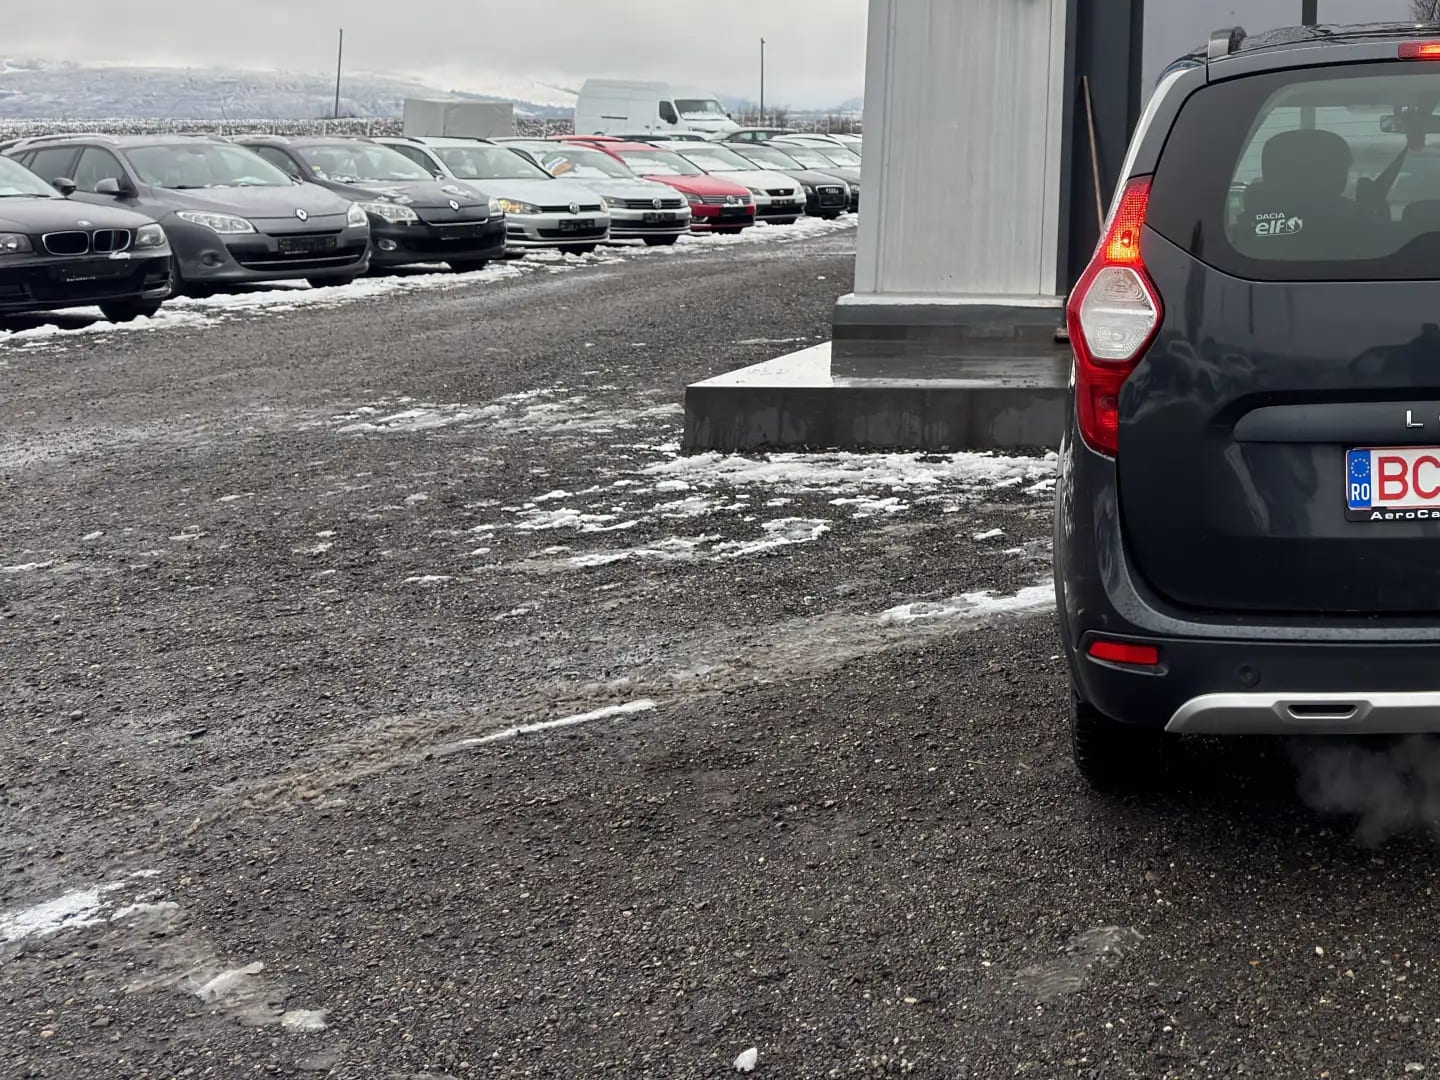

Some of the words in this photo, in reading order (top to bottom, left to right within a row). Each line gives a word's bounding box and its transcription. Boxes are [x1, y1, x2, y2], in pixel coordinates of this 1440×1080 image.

[1256, 212, 1286, 220] DACIA
[1255, 219, 1286, 234] elf
[1351, 483, 1370, 501] RO
